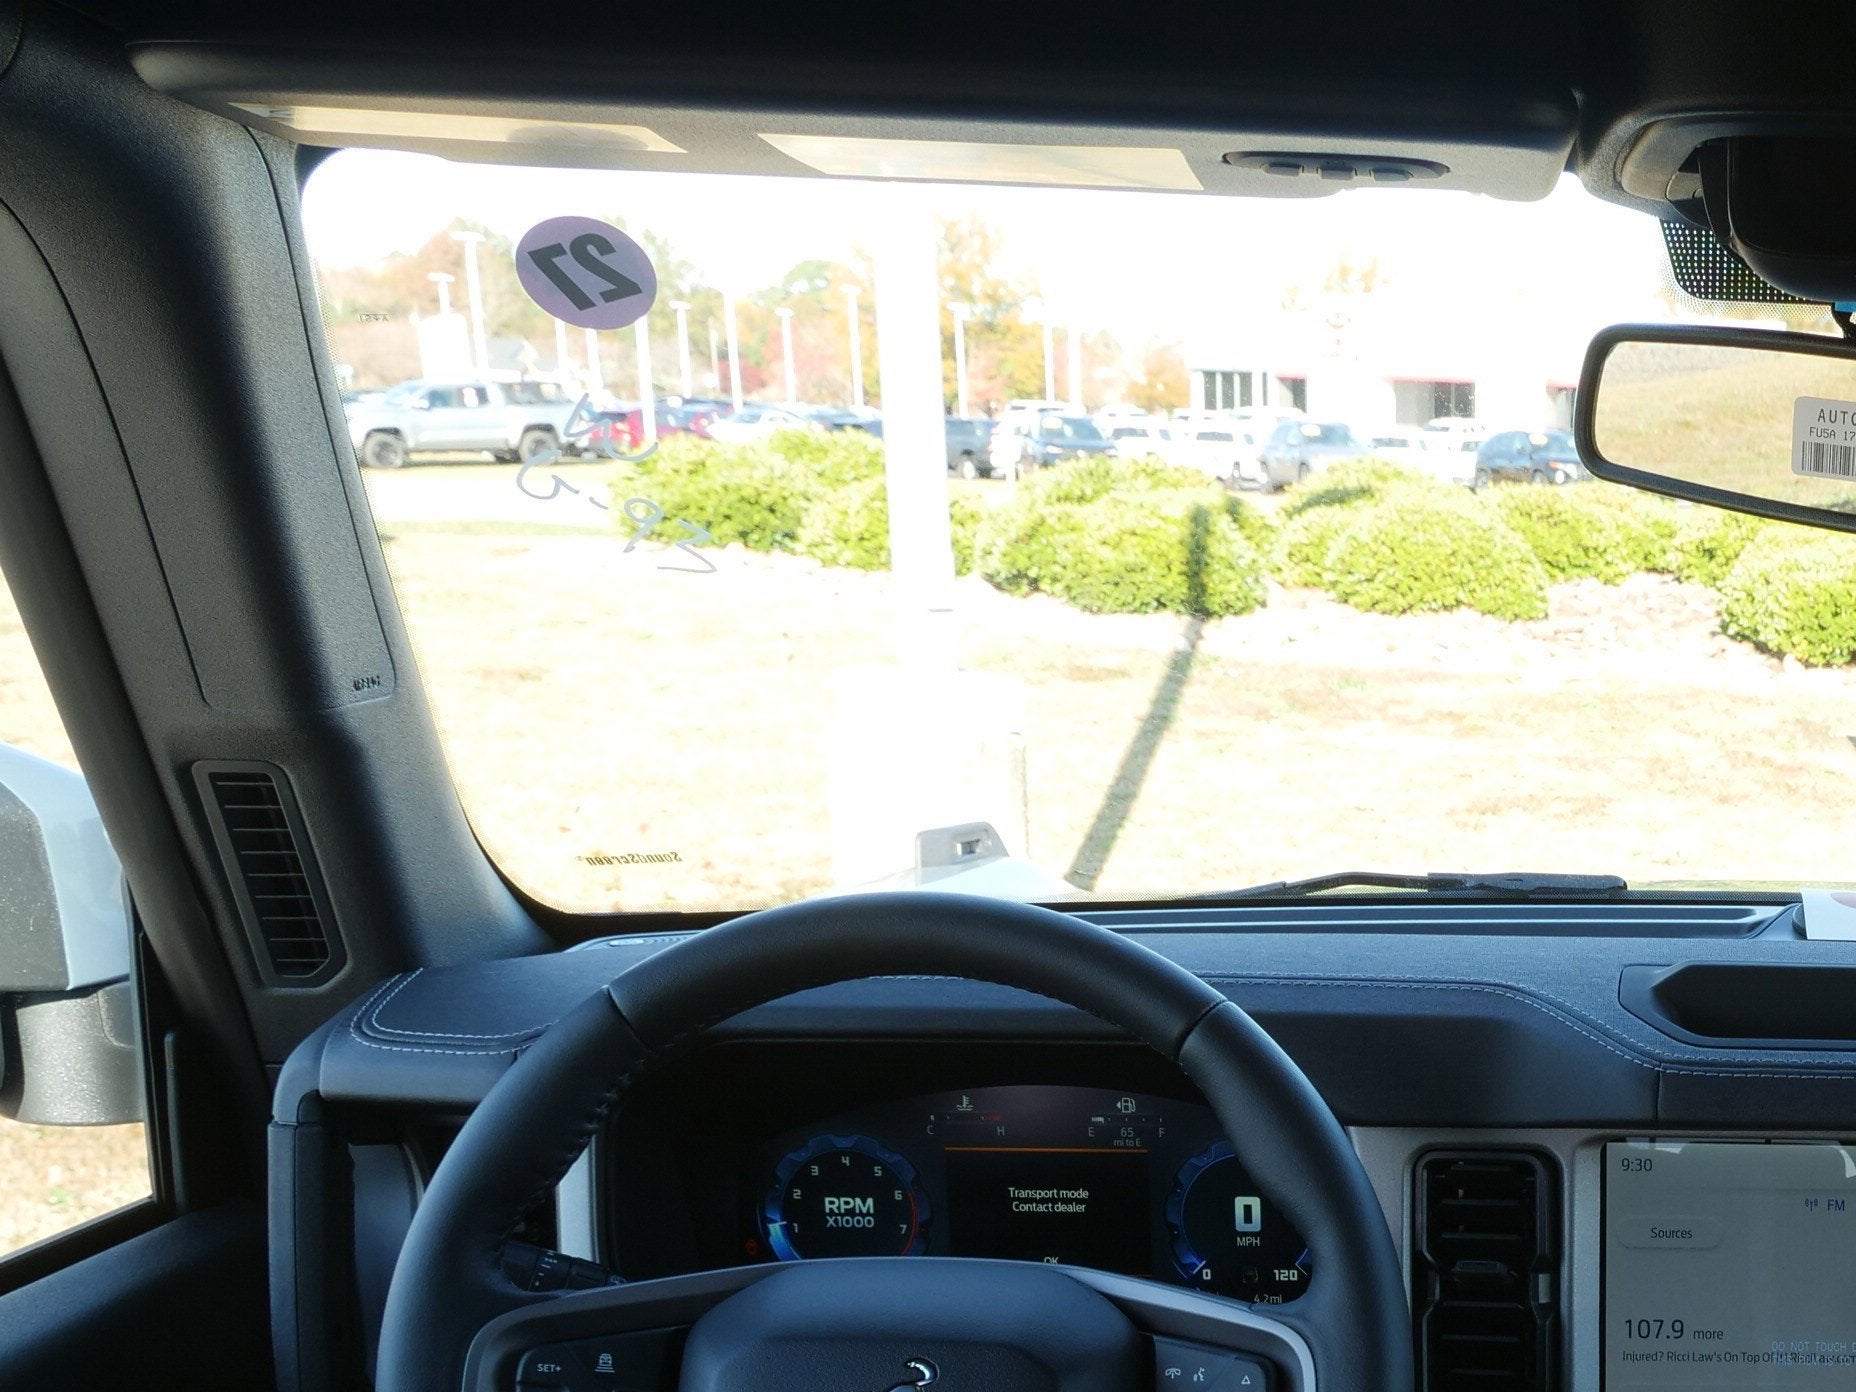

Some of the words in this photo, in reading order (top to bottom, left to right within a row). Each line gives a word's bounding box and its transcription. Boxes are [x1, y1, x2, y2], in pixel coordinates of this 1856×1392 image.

[1809, 426, 1836, 439] FU5A
[927, 1125, 934, 1135] C
[997, 1126, 1005, 1136] H
[1088, 1127, 1095, 1137] E
[1120, 1127, 1134, 1137] 65
[1159, 1128, 1165, 1138] F
[1126, 1139, 1135, 1147] to
[841, 1156, 850, 1166] 4
[1621, 1158, 1652, 1172] 9:30
[810, 1166, 819, 1176] 3
[873, 1166, 882, 1176] 5
[793, 1189, 801, 1199] 2
[894, 1190, 902, 1200] 6
[1008, 1187, 1058, 1200] Transport
[1059, 1188, 1089, 1199] mode
[824, 1197, 875, 1214] RPM
[1013, 1202, 1051, 1212] Contact
[1055, 1202, 1086, 1213] dealer
[1827, 1199, 1845, 1211] FM
[1234, 1196, 1261, 1232] 0
[826, 1216, 875, 1228] X1000
[793, 1223, 799, 1233] 1
[900, 1224, 907, 1234] 7
[1651, 1227, 1693, 1239] Sources
[1236, 1237, 1260, 1246] MPH
[1202, 1269, 1211, 1280] 0
[1273, 1270, 1298, 1281] 120
[1625, 1319, 1684, 1339] 107.9
[1694, 1330, 1723, 1340] more
[1771, 1341, 1785, 1351] DO
[1791, 1341, 1810, 1351] NOT
[1815, 1342, 1847, 1352] TOUCH
[1622, 1351, 1664, 1363] Injured?
[1667, 1351, 1689, 1362] Ricci
[1693, 1351, 1721, 1362] Law's
[1724, 1352, 1738, 1362] On
[1741, 1352, 1760, 1364] Top
[1762, 1352, 1775, 1362] Of
